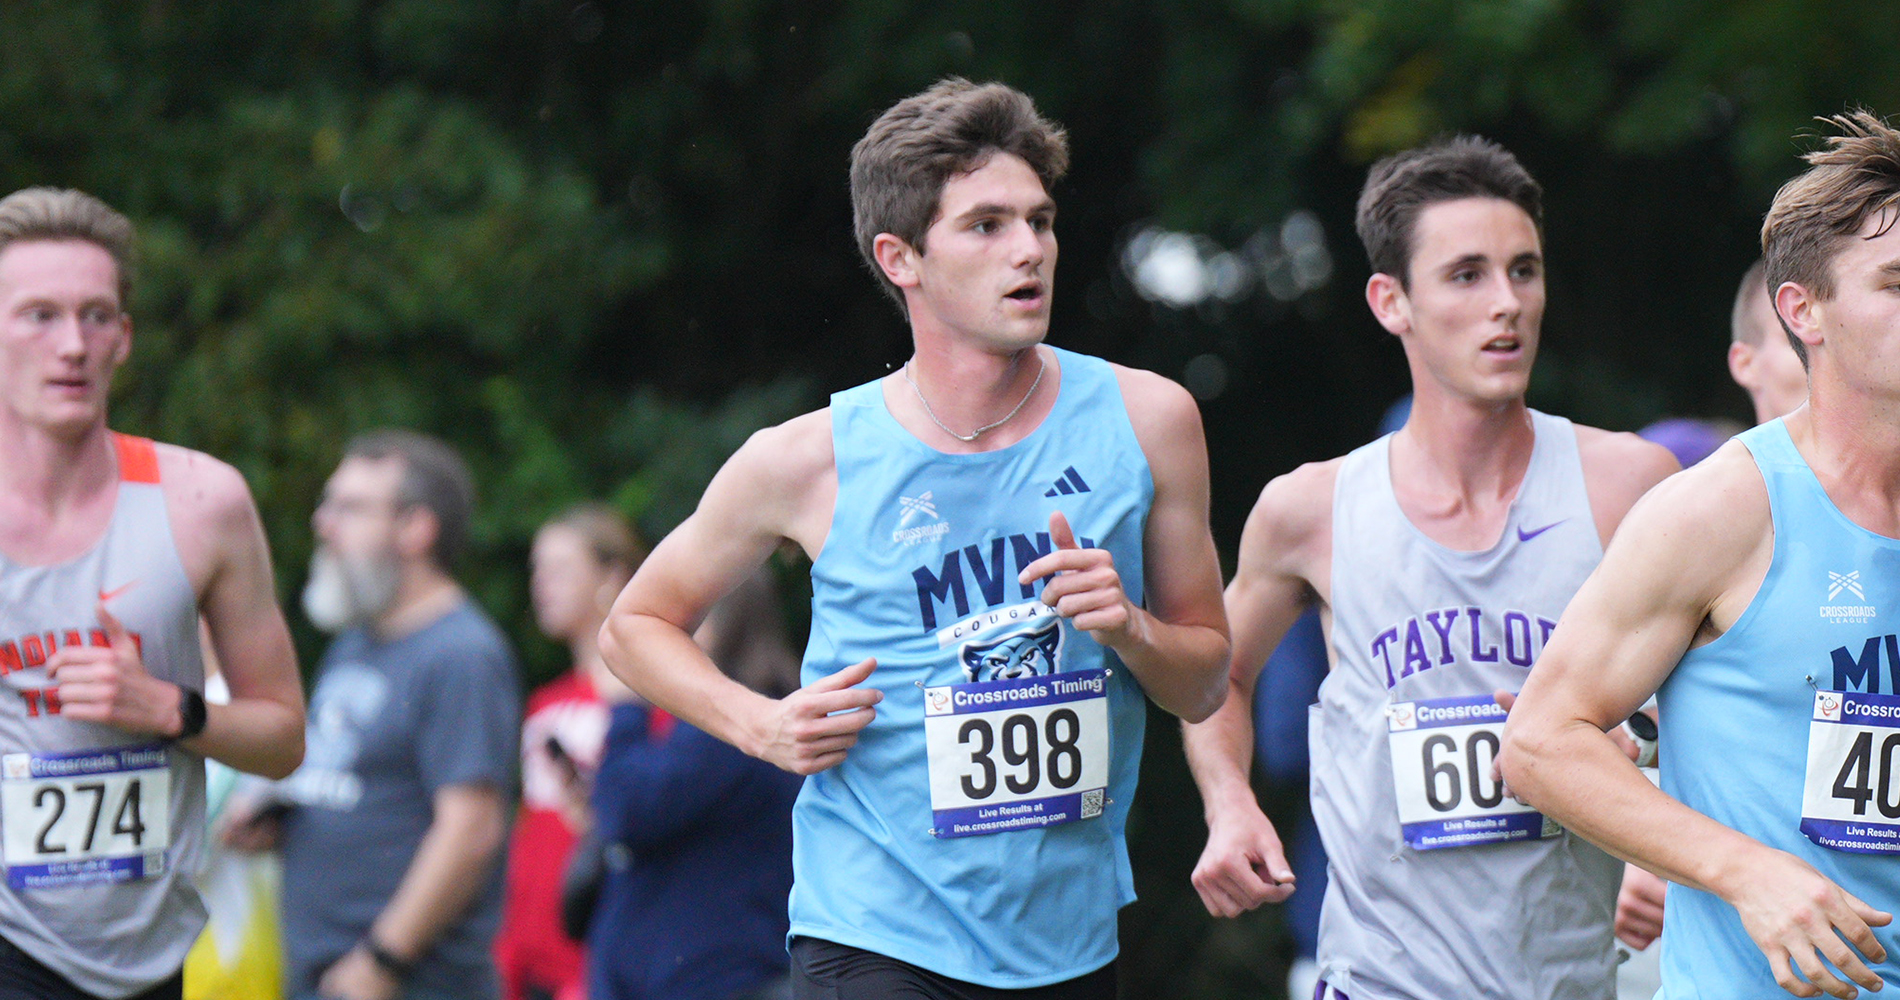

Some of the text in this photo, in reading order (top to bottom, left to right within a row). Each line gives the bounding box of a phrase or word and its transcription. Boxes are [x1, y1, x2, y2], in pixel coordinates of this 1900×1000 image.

[893, 521, 950, 543] CROSSROADS
[911, 532, 1094, 634] MVN
[1820, 606, 1876, 618] CROSSROADS
[955, 678, 1103, 706] Crossroads Timing
[958, 708, 1082, 800] 398
[1422, 730, 1538, 812] 60
[33, 778, 145, 854] 274
[979, 803, 1043, 818] Live Results at
[954, 812, 1066, 833] live.crossroadstiming.com
[1443, 822, 1463, 831] Live
[1464, 819, 1496, 828] Results
[1846, 826, 1897, 838] Live Results
